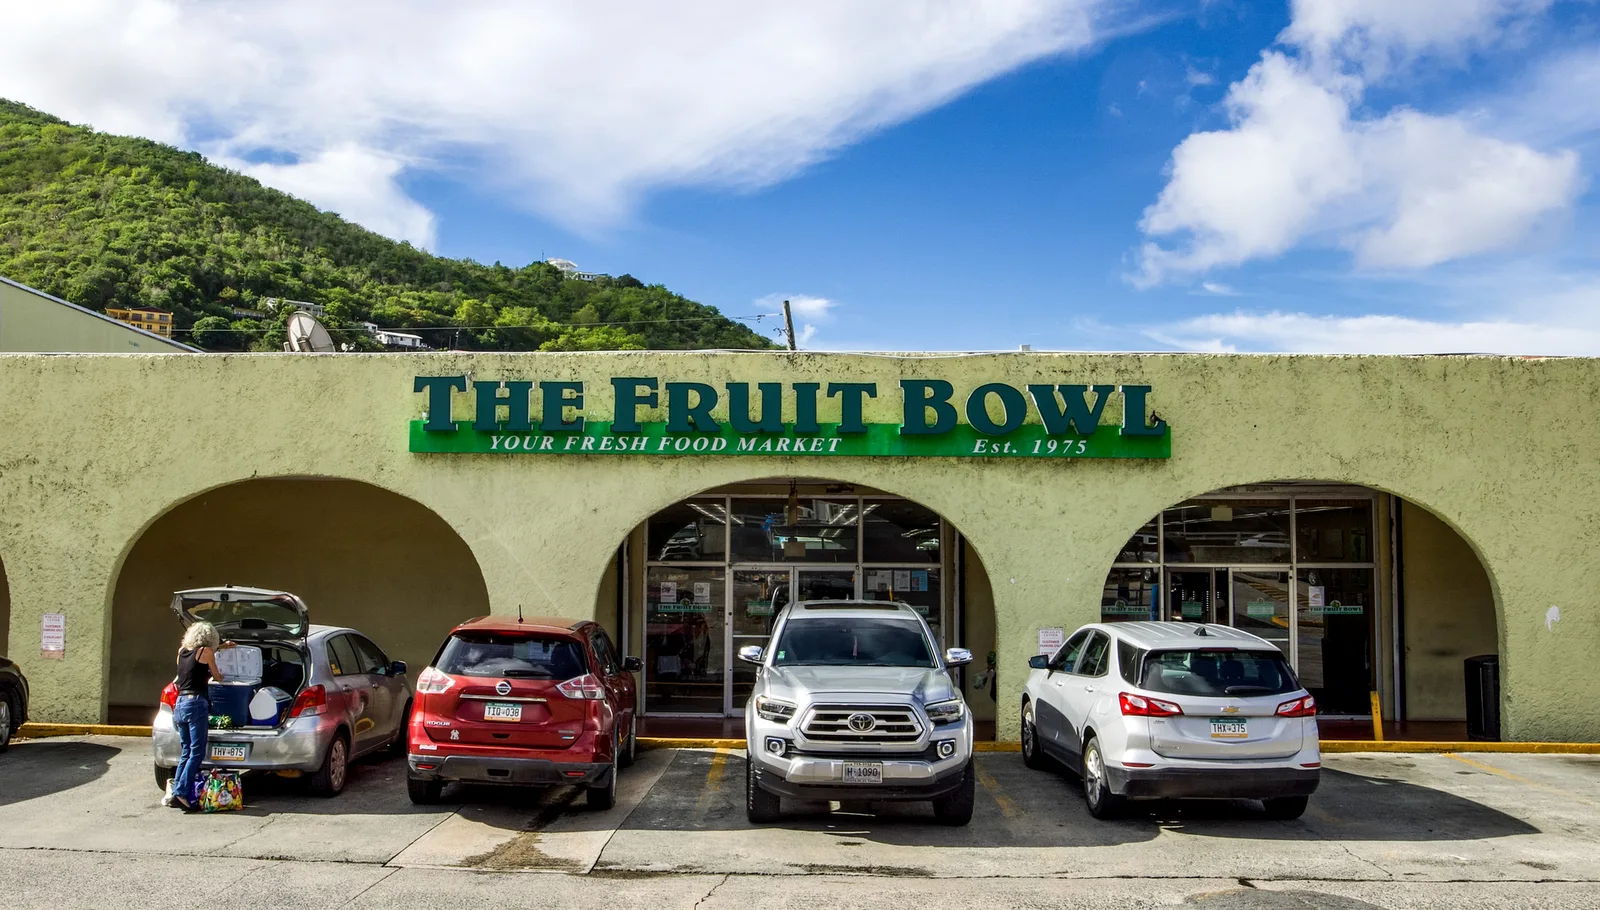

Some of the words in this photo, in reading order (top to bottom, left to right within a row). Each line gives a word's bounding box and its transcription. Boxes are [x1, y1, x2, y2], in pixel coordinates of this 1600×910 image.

[413, 375, 585, 432] THE
[610, 376, 878, 433] FRUIT
[899, 379, 1167, 435] BOWL
[490, 435, 554, 450] YOUR
[563, 436, 650, 451] FRESH
[657, 436, 728, 451] FOOD
[736, 437, 842, 452] MARKET
[972, 438, 1018, 454] Est.
[1031, 439, 1088, 454] 1975
